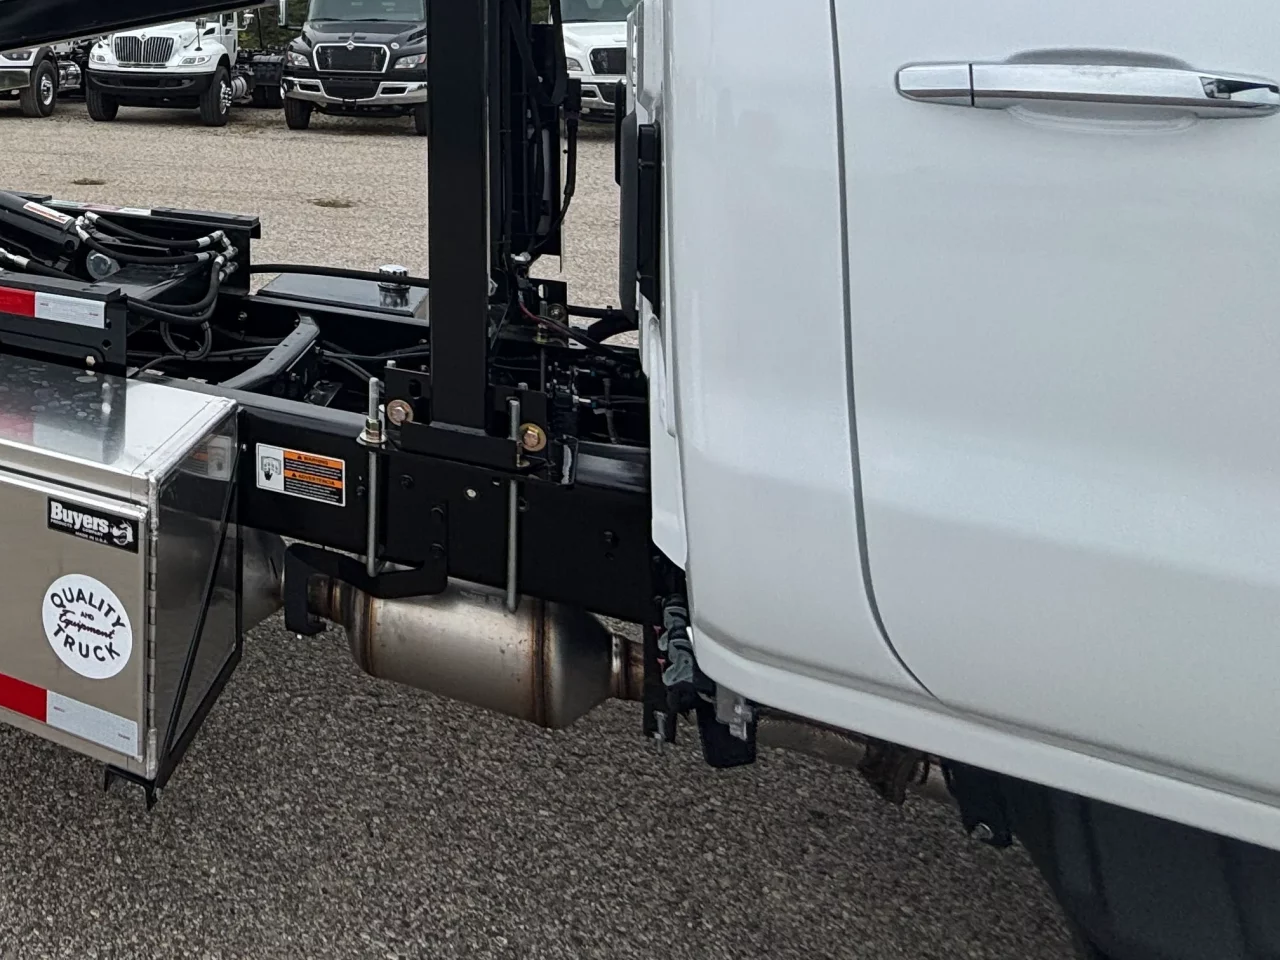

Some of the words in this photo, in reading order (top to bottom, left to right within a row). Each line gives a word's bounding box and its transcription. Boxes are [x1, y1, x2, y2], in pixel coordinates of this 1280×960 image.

[50, 501, 109, 534] Buyers
[50, 587, 126, 628] QUALITY
[58, 609, 115, 639] Equipment
[80, 611, 95, 621] AND
[53, 623, 121, 662] TRUCK
